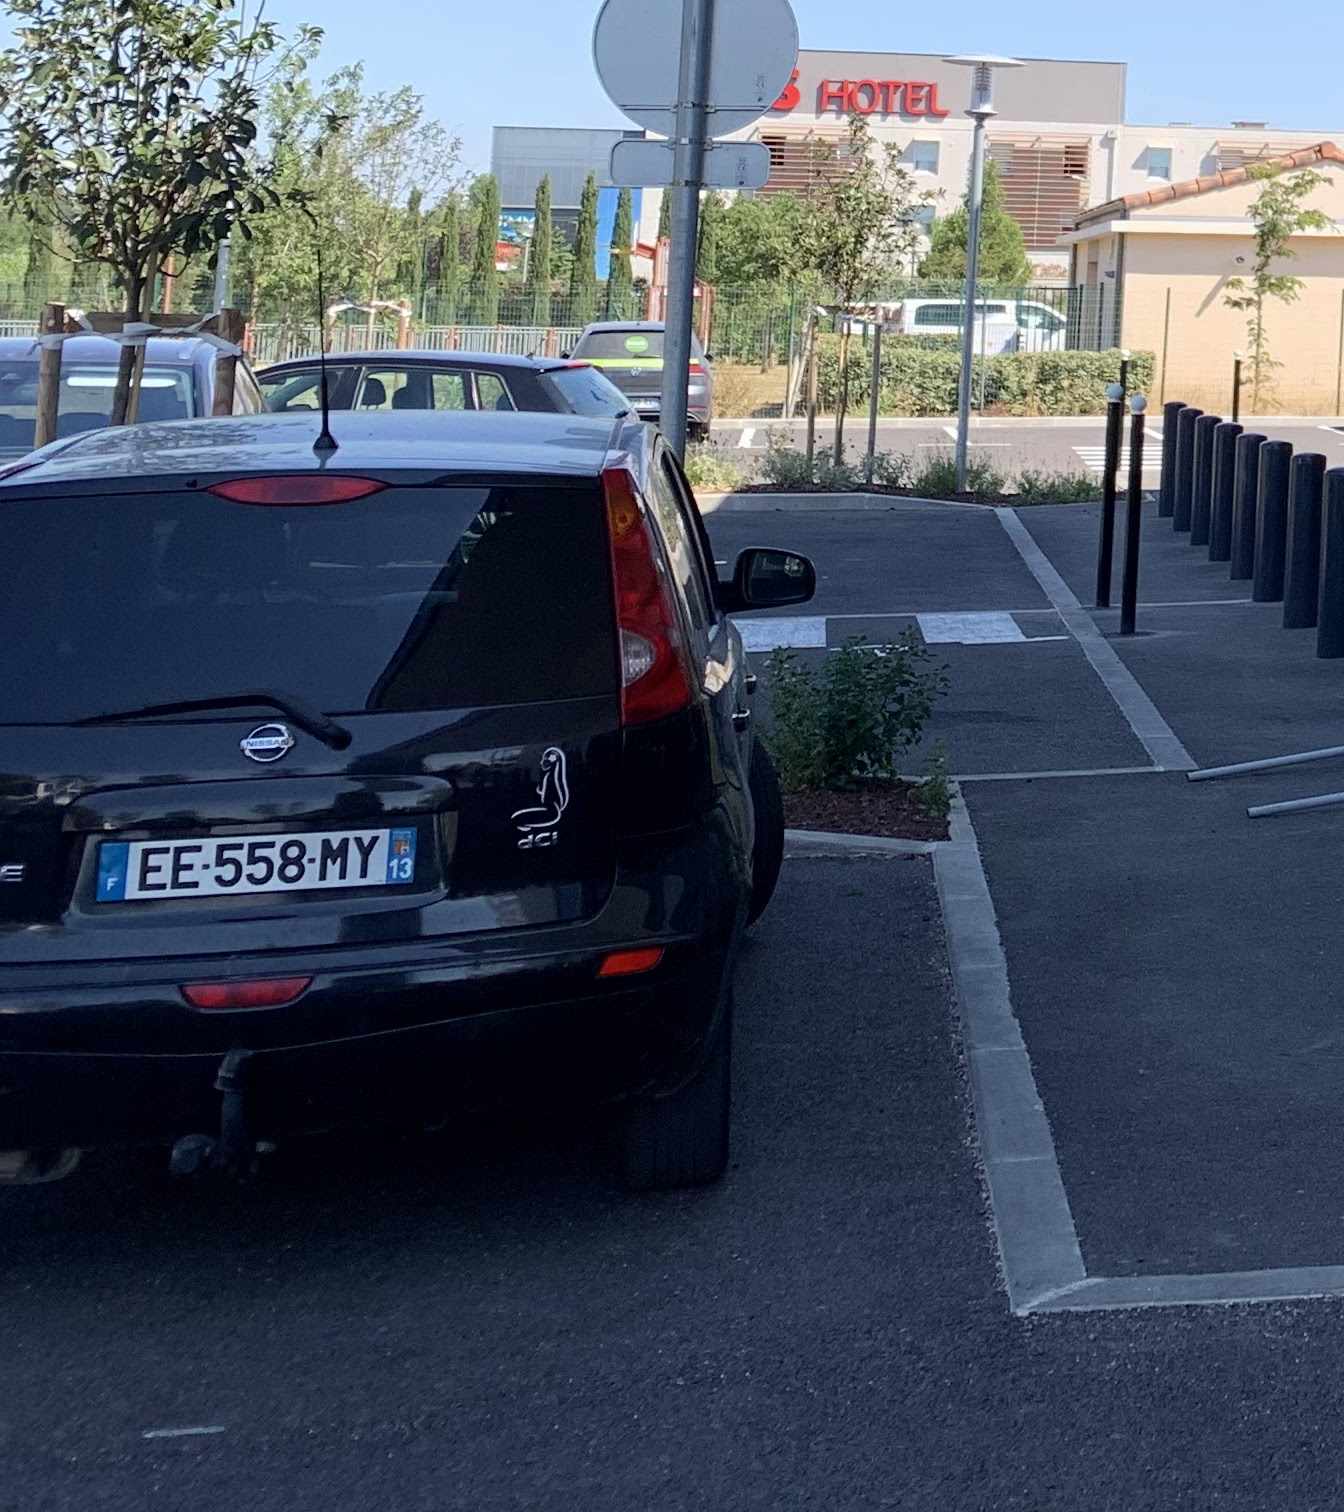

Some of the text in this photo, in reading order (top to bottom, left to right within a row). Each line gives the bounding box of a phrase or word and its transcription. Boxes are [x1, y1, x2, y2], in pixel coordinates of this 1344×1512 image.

[820, 79, 950, 116] HOTEL
[246, 739, 289, 747] NISSAN
[518, 832, 557, 848] dCi
[107, 836, 413, 891] F EE-558-MY 13
